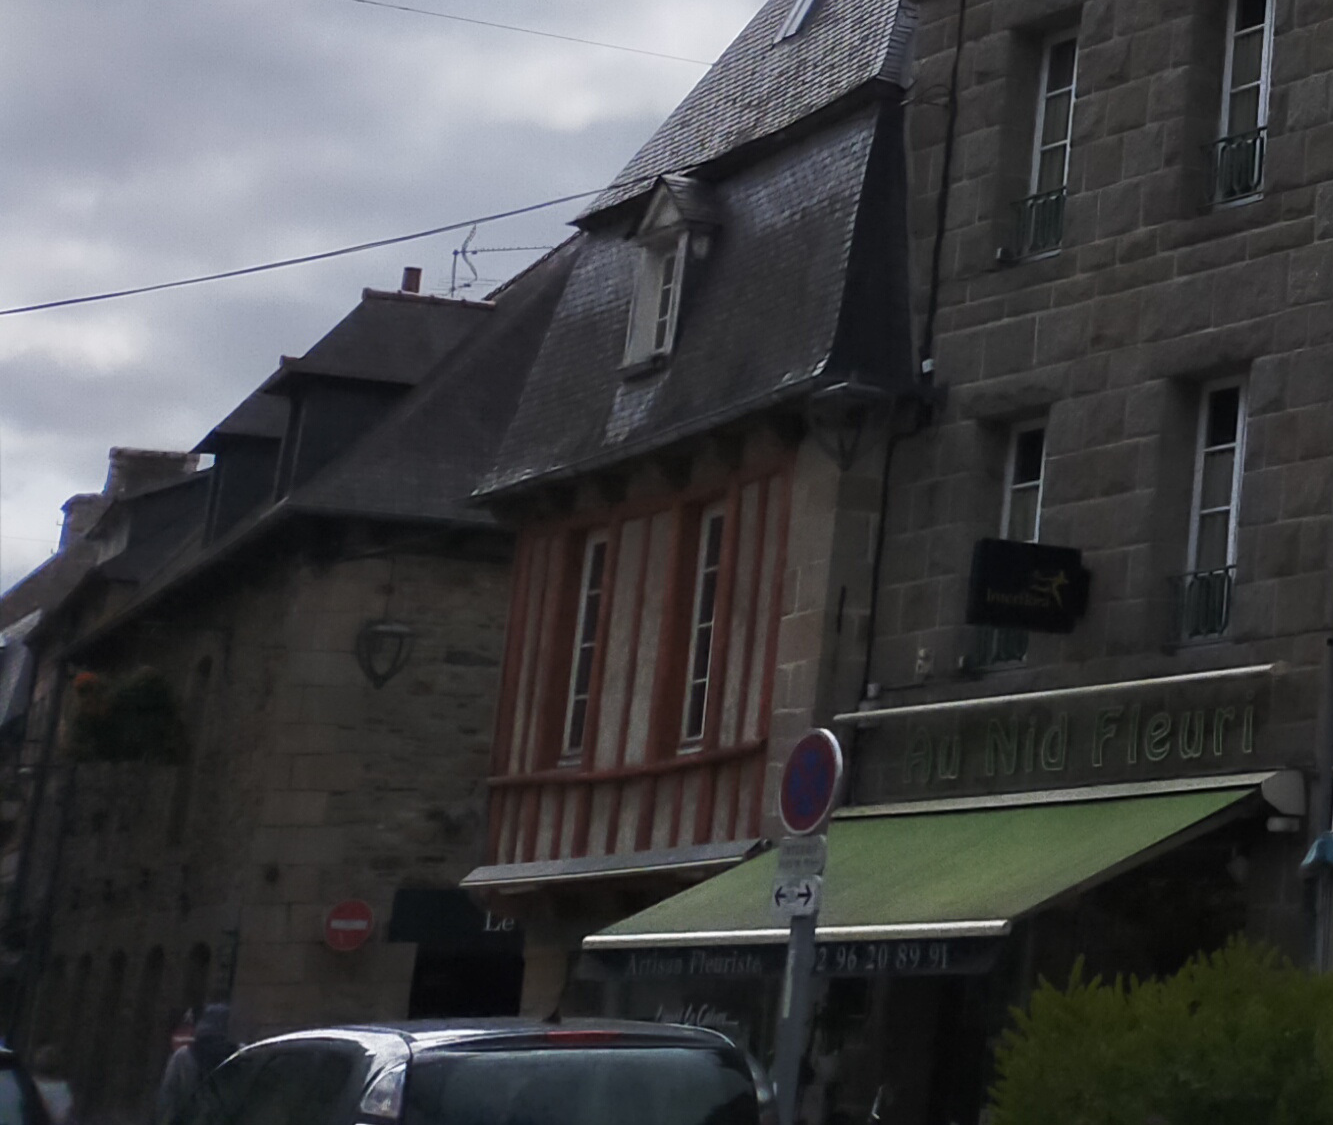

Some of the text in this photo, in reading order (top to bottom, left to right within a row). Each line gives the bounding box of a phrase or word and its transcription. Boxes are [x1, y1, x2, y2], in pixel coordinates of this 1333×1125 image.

[903, 689, 1254, 784] Au Nid Fleuri
[483, 909, 515, 932] Le
[835, 943, 857, 971] 96
[865, 942, 888, 970] 20
[896, 941, 920, 970] 89
[928, 941, 948, 969] 91
